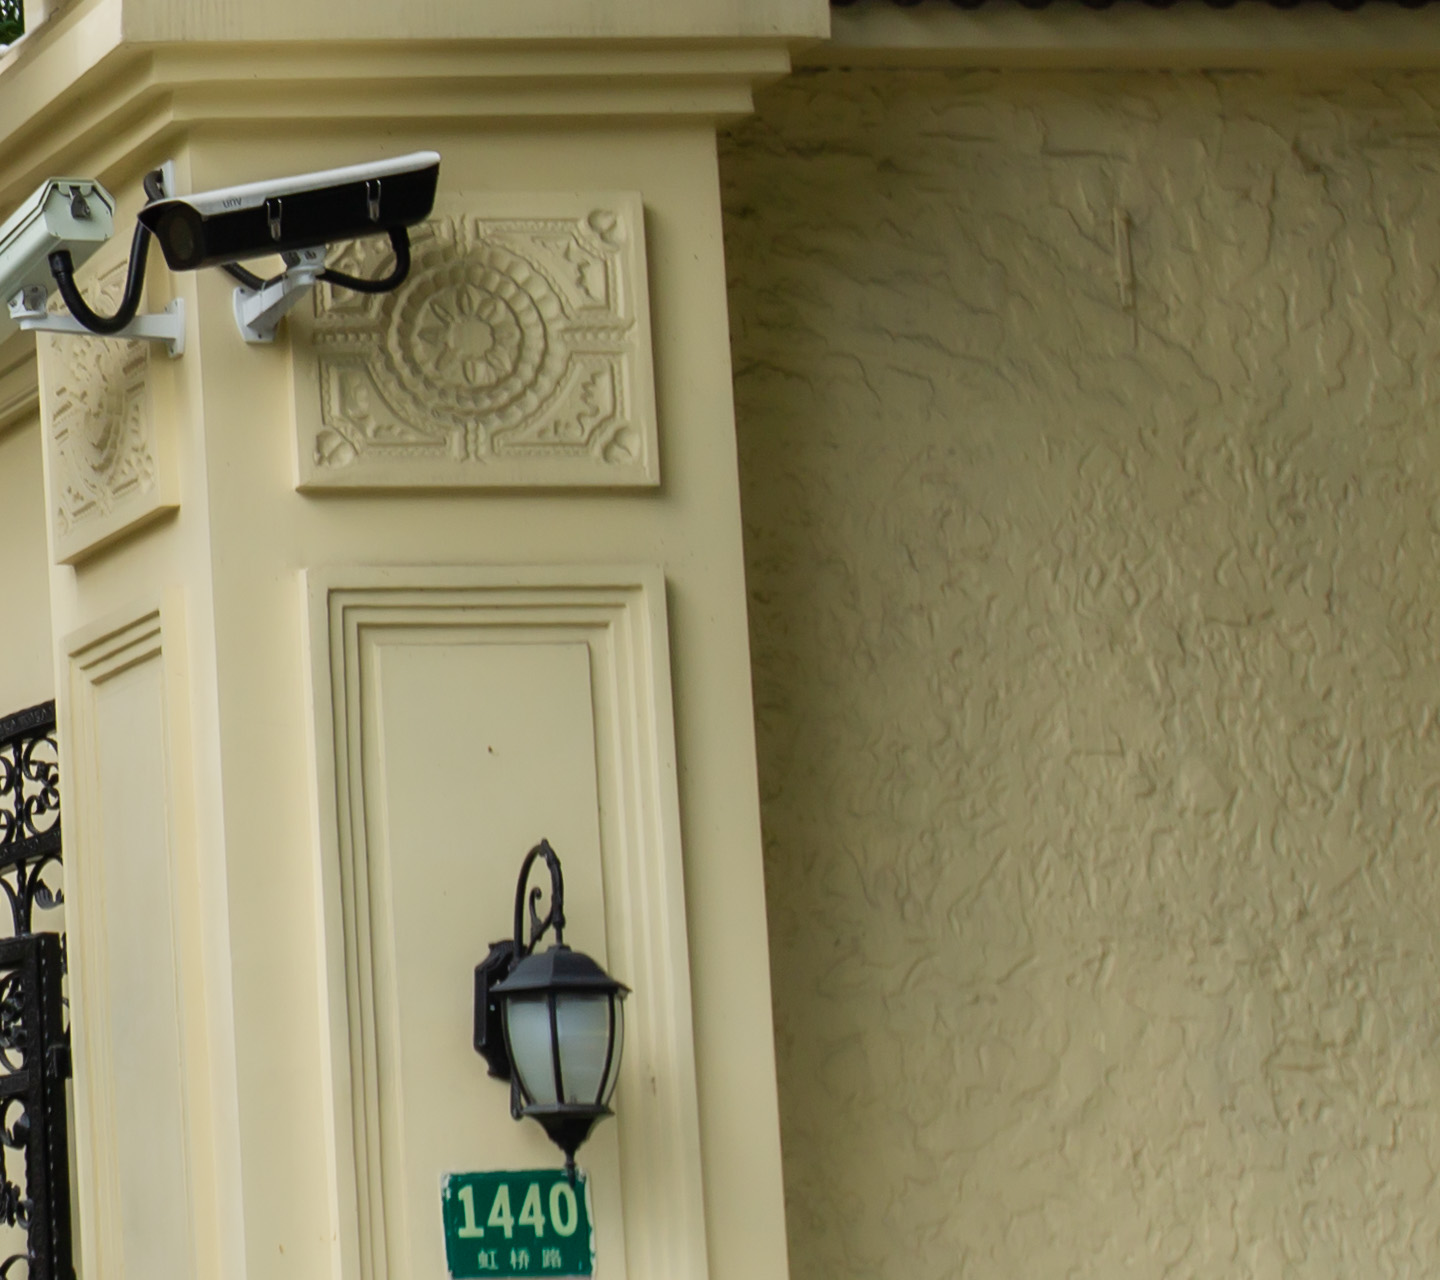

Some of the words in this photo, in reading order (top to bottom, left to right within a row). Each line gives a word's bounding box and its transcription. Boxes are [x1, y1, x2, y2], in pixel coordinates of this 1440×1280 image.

[458, 1181, 578, 1239] 1440
[478, 1247, 562, 1270] 虹桥路
